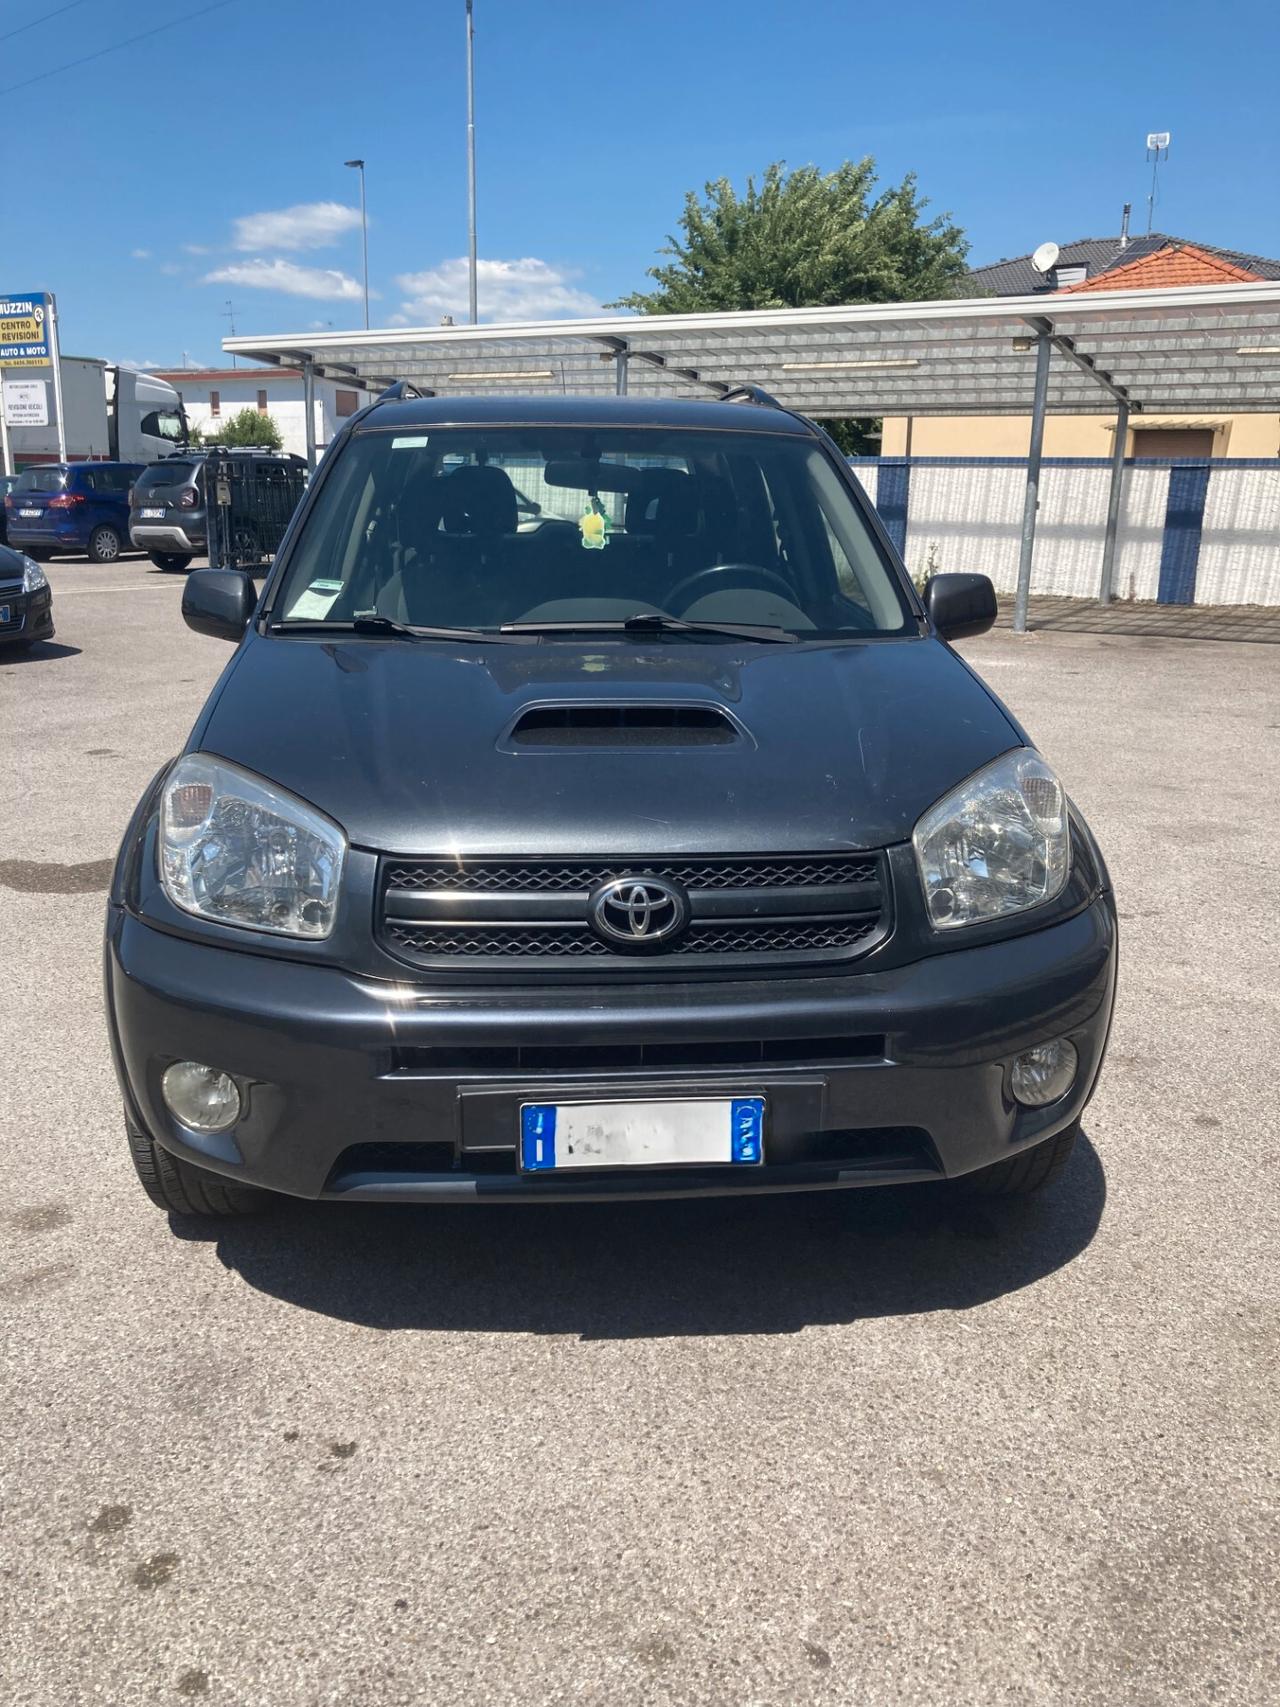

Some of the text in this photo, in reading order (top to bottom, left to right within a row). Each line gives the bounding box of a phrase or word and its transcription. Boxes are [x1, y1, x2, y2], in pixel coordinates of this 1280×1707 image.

[1, 321, 31, 330] CENTRO
[1, 332, 40, 341] REVISIONI
[1, 347, 46, 357] AUTO & MOTO
